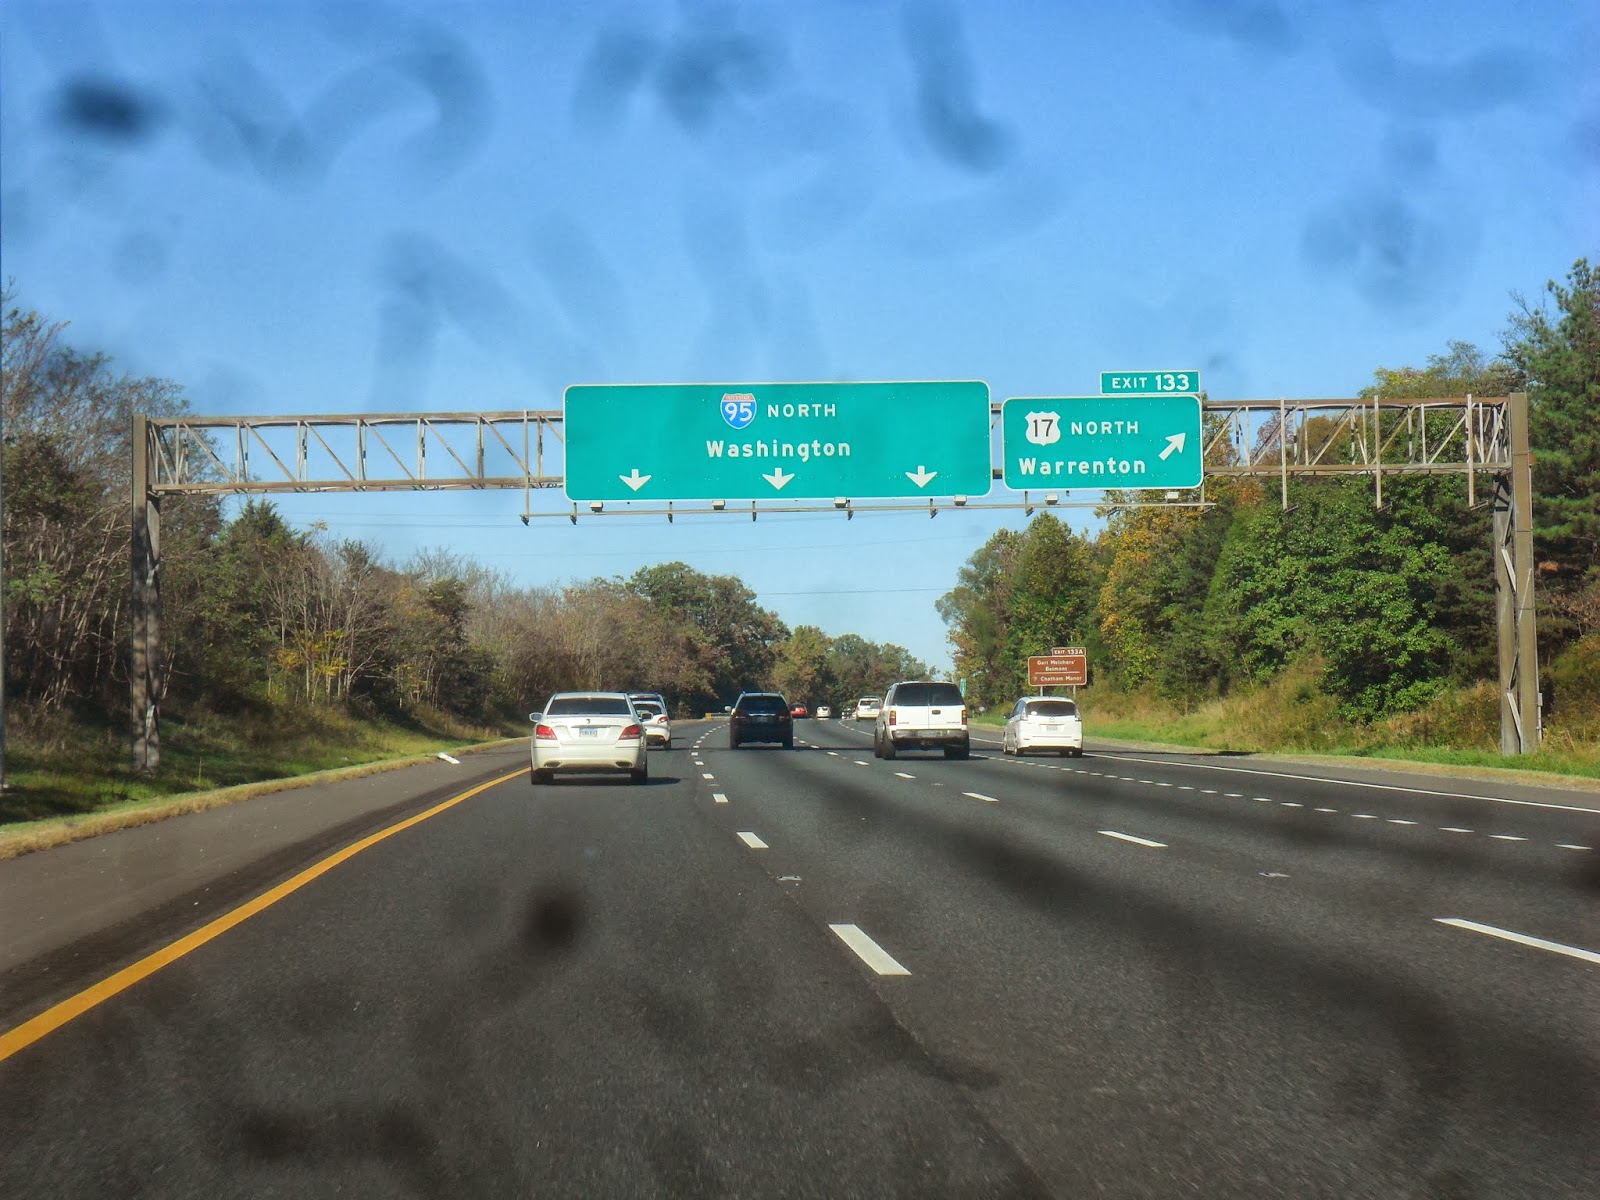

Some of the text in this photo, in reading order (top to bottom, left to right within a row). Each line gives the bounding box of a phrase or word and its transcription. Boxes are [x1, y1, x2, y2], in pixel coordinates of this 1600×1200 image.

[1112, 374, 1190, 391] EXIT 133
[724, 402, 836, 422] 95 NORTH
[1033, 418, 1139, 438] 17 NORTH
[706, 439, 851, 463] Washington
[1018, 456, 1146, 475] Warrenton
